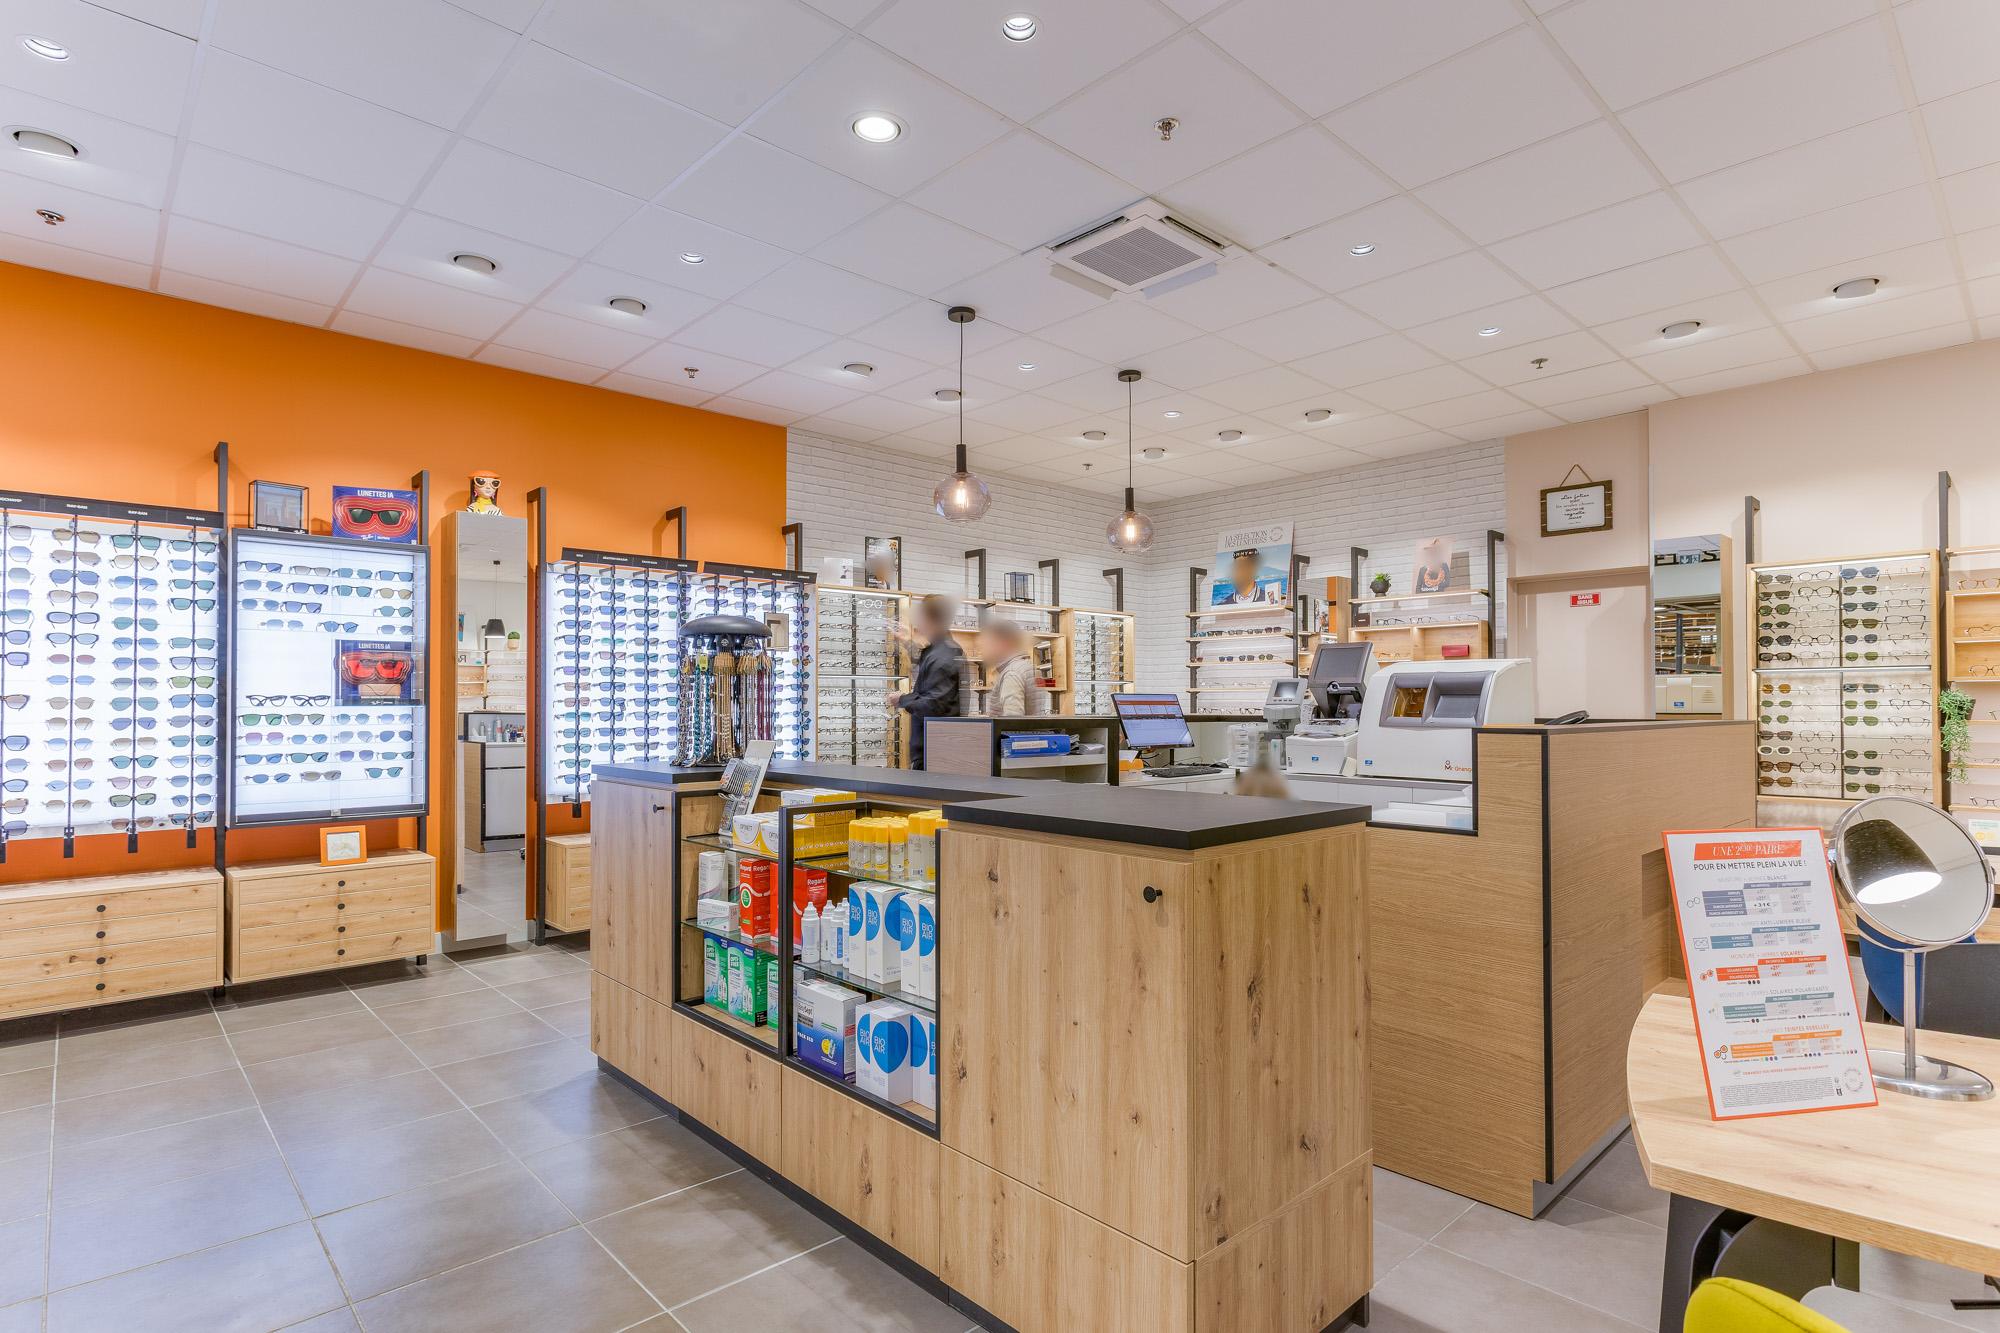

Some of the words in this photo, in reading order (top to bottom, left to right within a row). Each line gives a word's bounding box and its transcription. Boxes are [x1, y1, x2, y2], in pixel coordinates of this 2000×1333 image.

[357, 489, 386, 498] LUNETTES
[358, 642, 384, 650] LUNETTES
[1712, 845, 1734, 857] UNE
[1693, 862, 1715, 871] POUR
[1716, 862, 1727, 870] EN
[1728, 861, 1756, 869] METTRE
[1757, 860, 1777, 868] PLEIN
[807, 878, 826, 886] Regard
[850, 905, 861, 913] BIO
[867, 909, 878, 918] BIO
[850, 912, 861, 921] AIR
[867, 917, 878, 926] AIR
[902, 918, 914, 927] BIO
[902, 926, 914, 935] AIR
[921, 922, 934, 932] BIO
[921, 931, 934, 940] AIR
[860, 1028, 870, 1037] BIO
[860, 1036, 870, 1046] AIR
[873, 1036, 886, 1046] BIO
[873, 1044, 886, 1055] AIR
